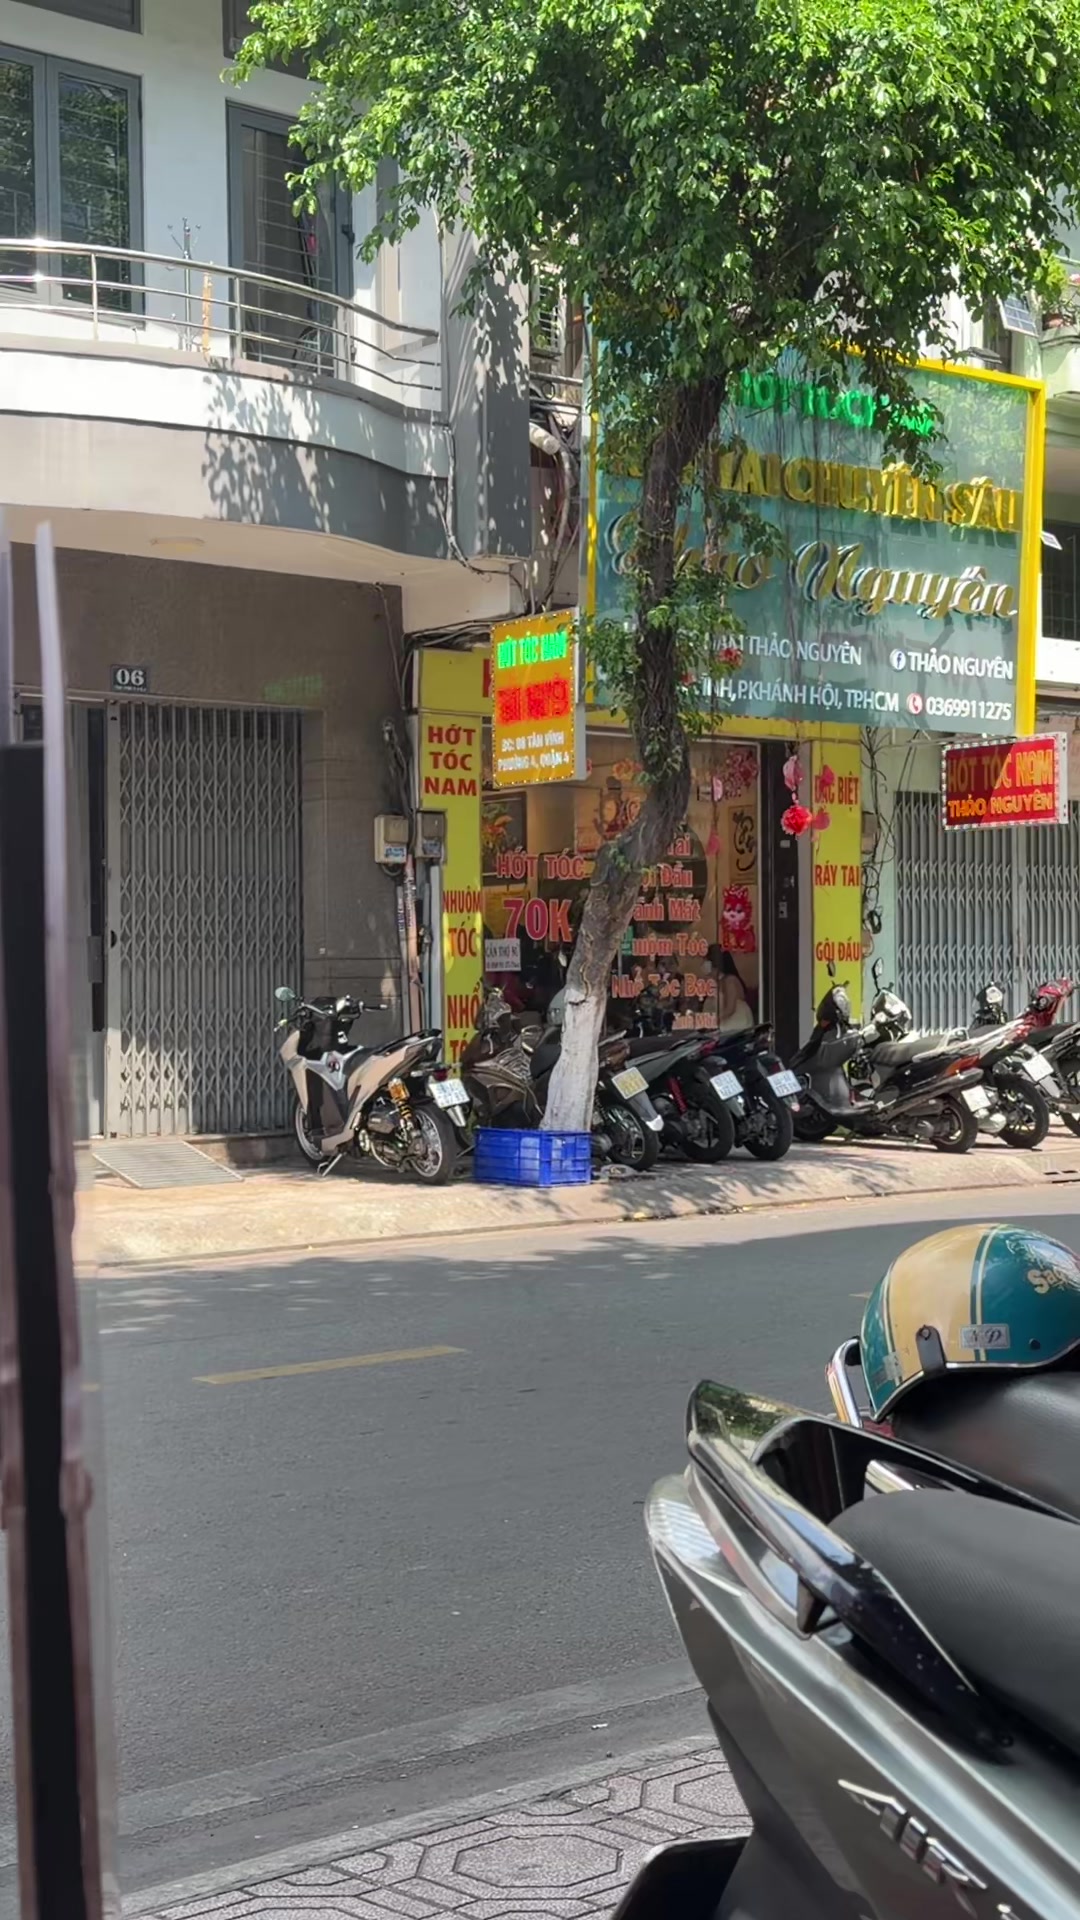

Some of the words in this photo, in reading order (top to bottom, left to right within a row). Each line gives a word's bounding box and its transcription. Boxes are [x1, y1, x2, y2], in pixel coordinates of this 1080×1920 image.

[782, 456, 942, 520] CHUYÊN
[943, 476, 1024, 530] SÂU
[789, 541, 1018, 619] Nguyên
[749, 632, 791, 659] THẢO
[796, 640, 862, 666] NGUYÊN
[116, 668, 145, 686] 06
[908, 648, 951, 674] THẢO
[952, 656, 1013, 680] NGUYÊN
[844, 688, 900, 713] TP.HCM
[926, 696, 1012, 721] 0369911275
[428, 724, 476, 746] HỚT
[429, 749, 473, 771] TÓC
[1015, 748, 1054, 788] NAM
[424, 776, 477, 797] NAM
[838, 771, 860, 812] BIỆT
[990, 788, 1054, 815] NGUYÊN
[543, 847, 586, 881] TÓC
[815, 860, 838, 886] RÁY
[841, 864, 861, 887] TAI
[502, 896, 574, 943] 70K
[448, 921, 477, 957] TÓC
[675, 931, 710, 957] Tóc
